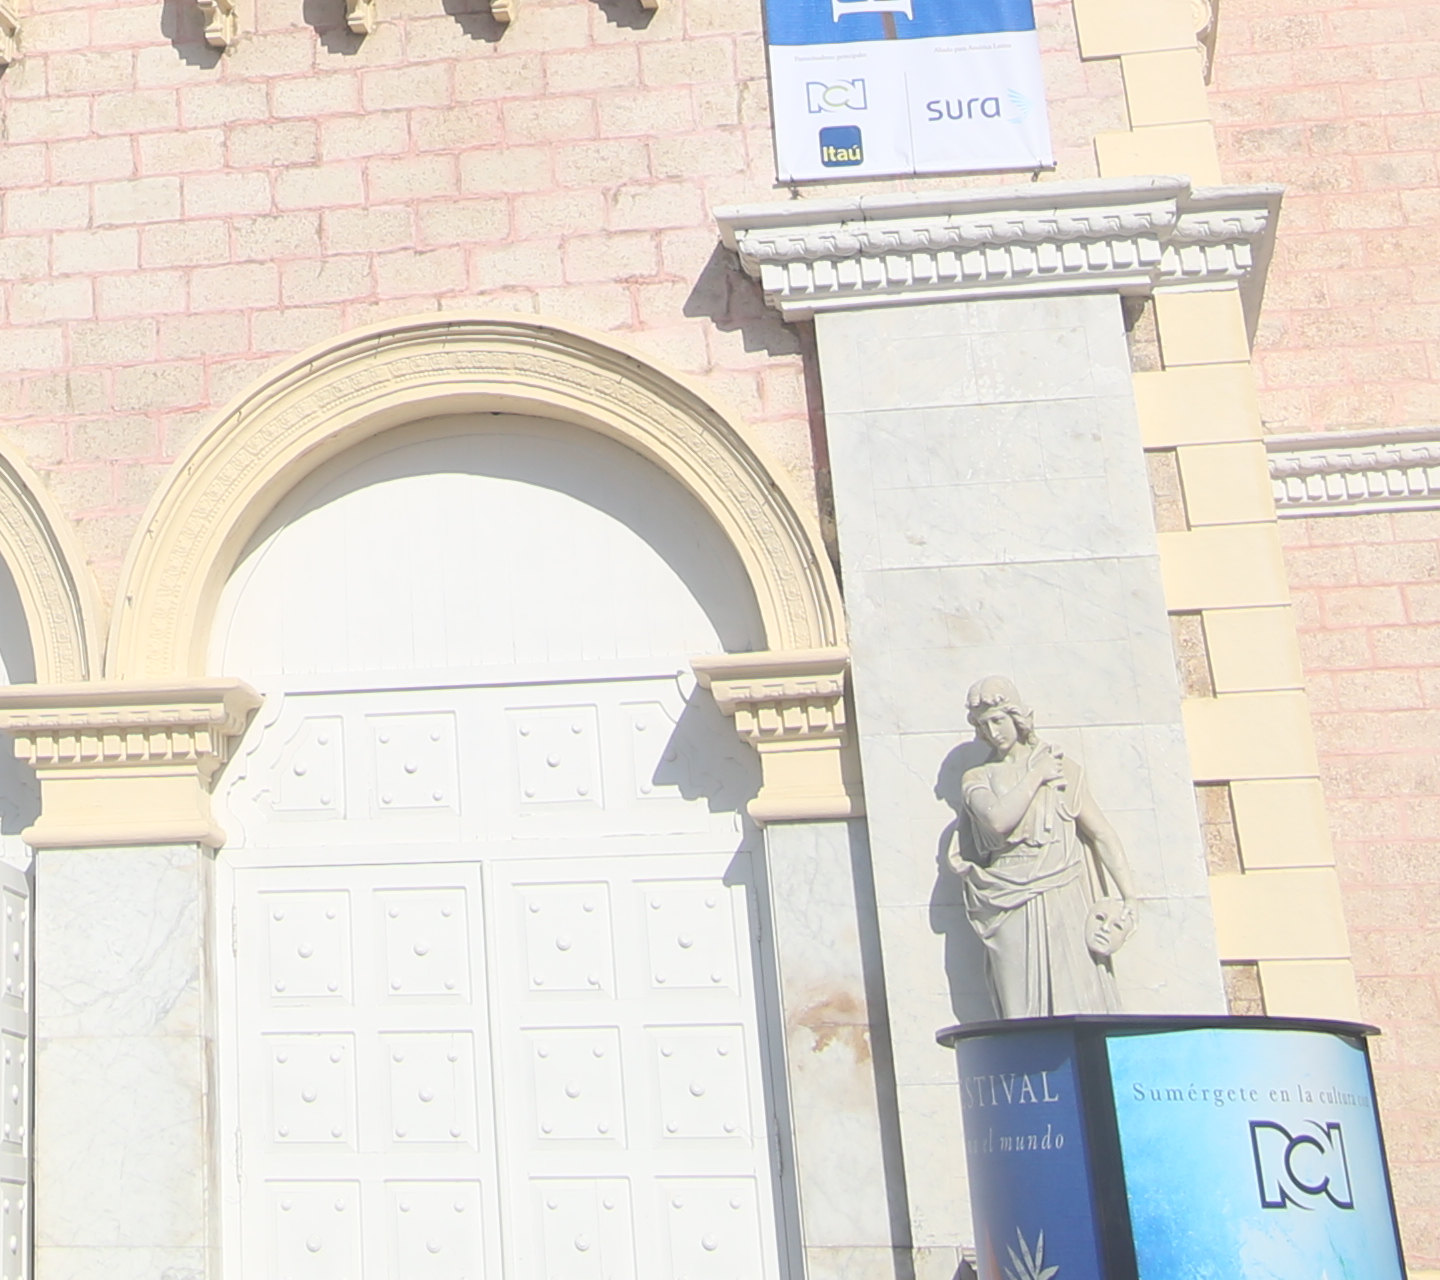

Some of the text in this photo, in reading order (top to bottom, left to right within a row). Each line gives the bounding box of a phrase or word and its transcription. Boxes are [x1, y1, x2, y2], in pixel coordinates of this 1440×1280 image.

[926, 96, 1001, 121] sura
[822, 144, 861, 162] Itaú
[1133, 1082, 1258, 1108] Sumérgete
[1270, 1089, 1290, 1103] en
[1298, 1085, 1313, 1103] la
[1319, 1085, 1356, 1106] cultura
[1000, 1124, 1064, 1152] mundo
